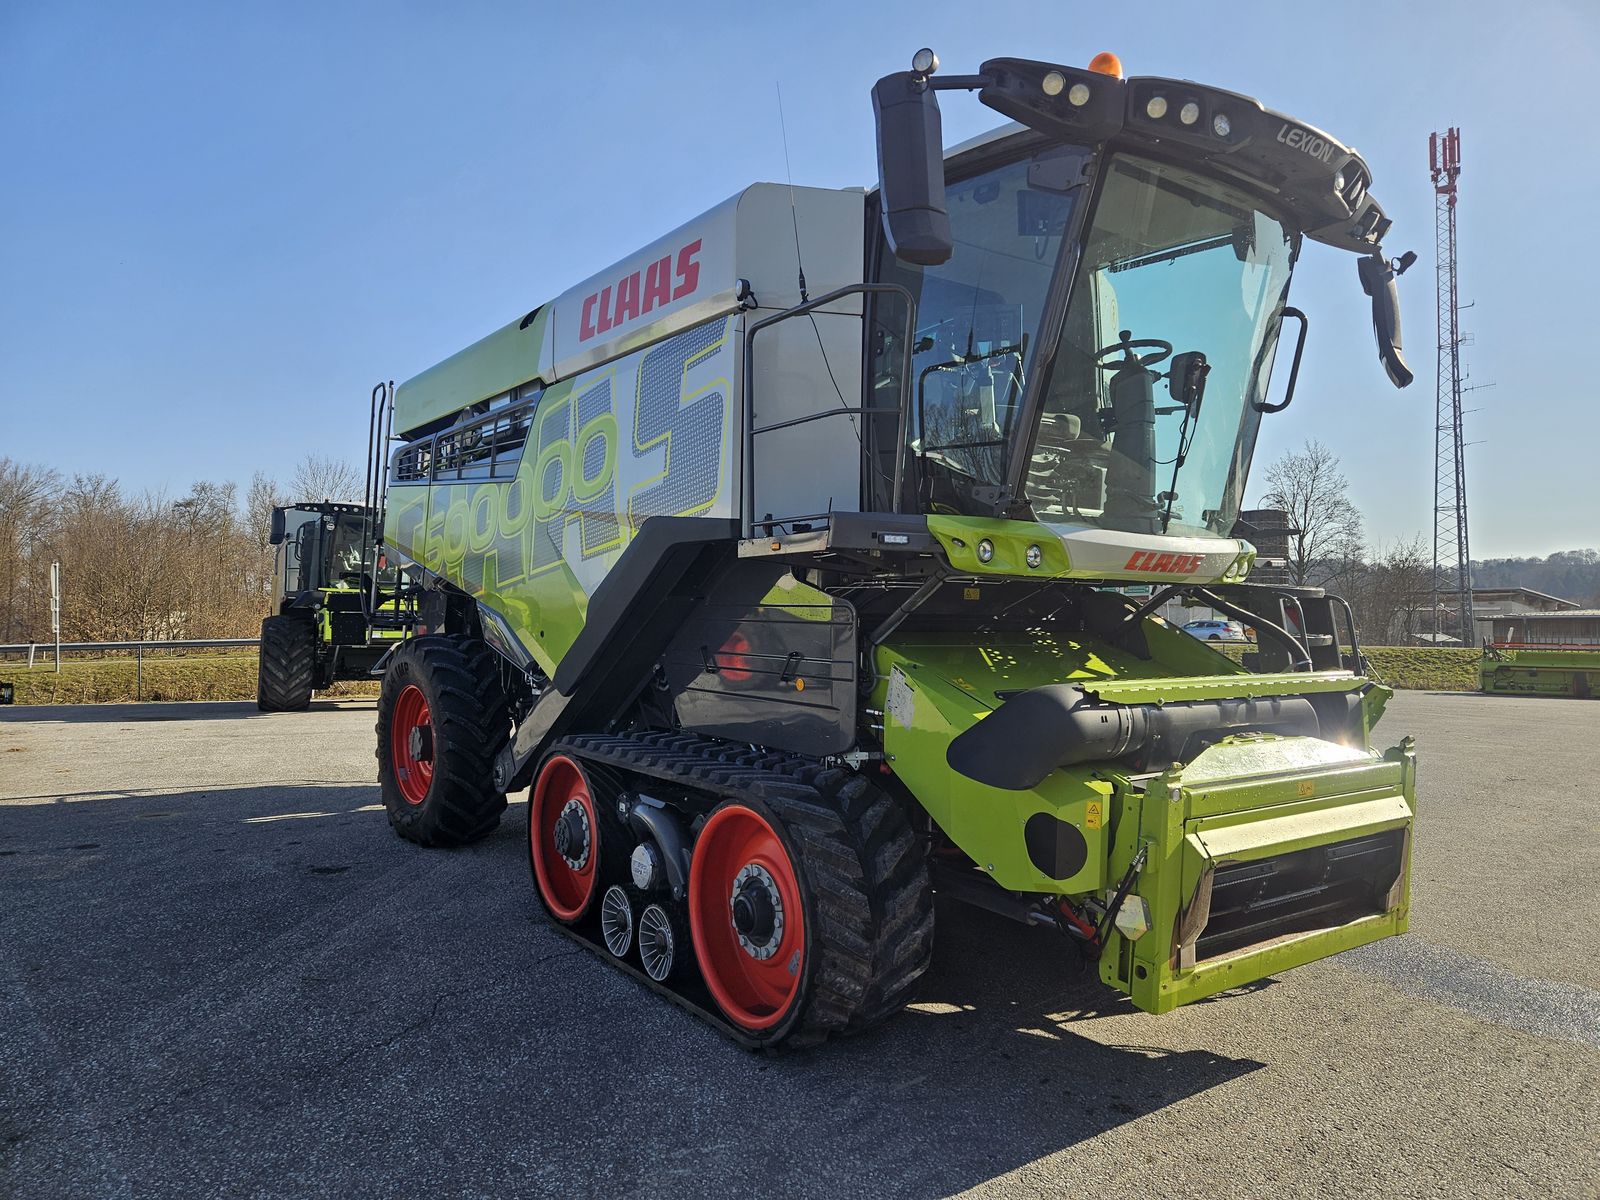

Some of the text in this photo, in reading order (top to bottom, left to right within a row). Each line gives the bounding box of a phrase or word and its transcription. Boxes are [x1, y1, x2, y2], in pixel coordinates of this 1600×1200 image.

[1276, 124, 1335, 162] LEXION
[579, 238, 702, 342] CLAAS
[1123, 550, 1206, 574] CLAAS
